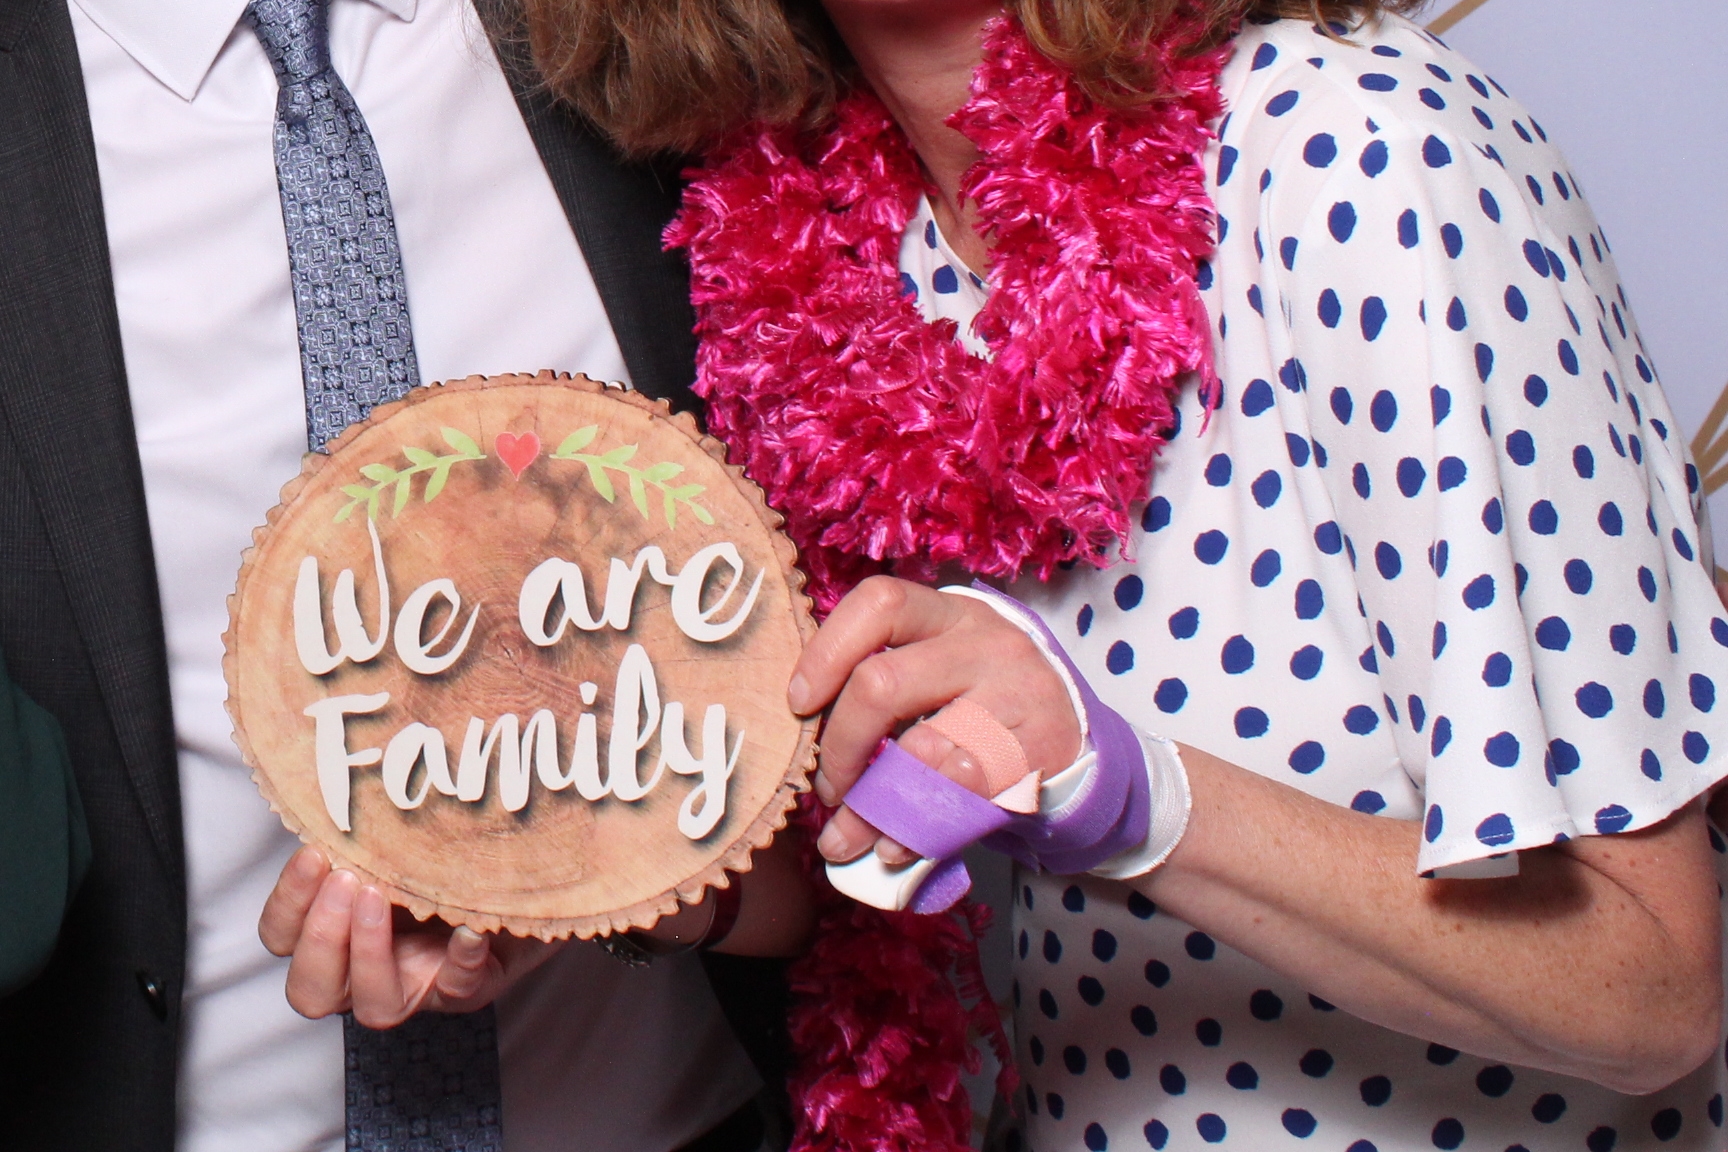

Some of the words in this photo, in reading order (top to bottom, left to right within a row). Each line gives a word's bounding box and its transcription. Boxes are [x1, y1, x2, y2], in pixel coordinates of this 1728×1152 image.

[293, 518, 481, 675] We
[518, 542, 765, 646] are
[303, 643, 745, 840] Family
